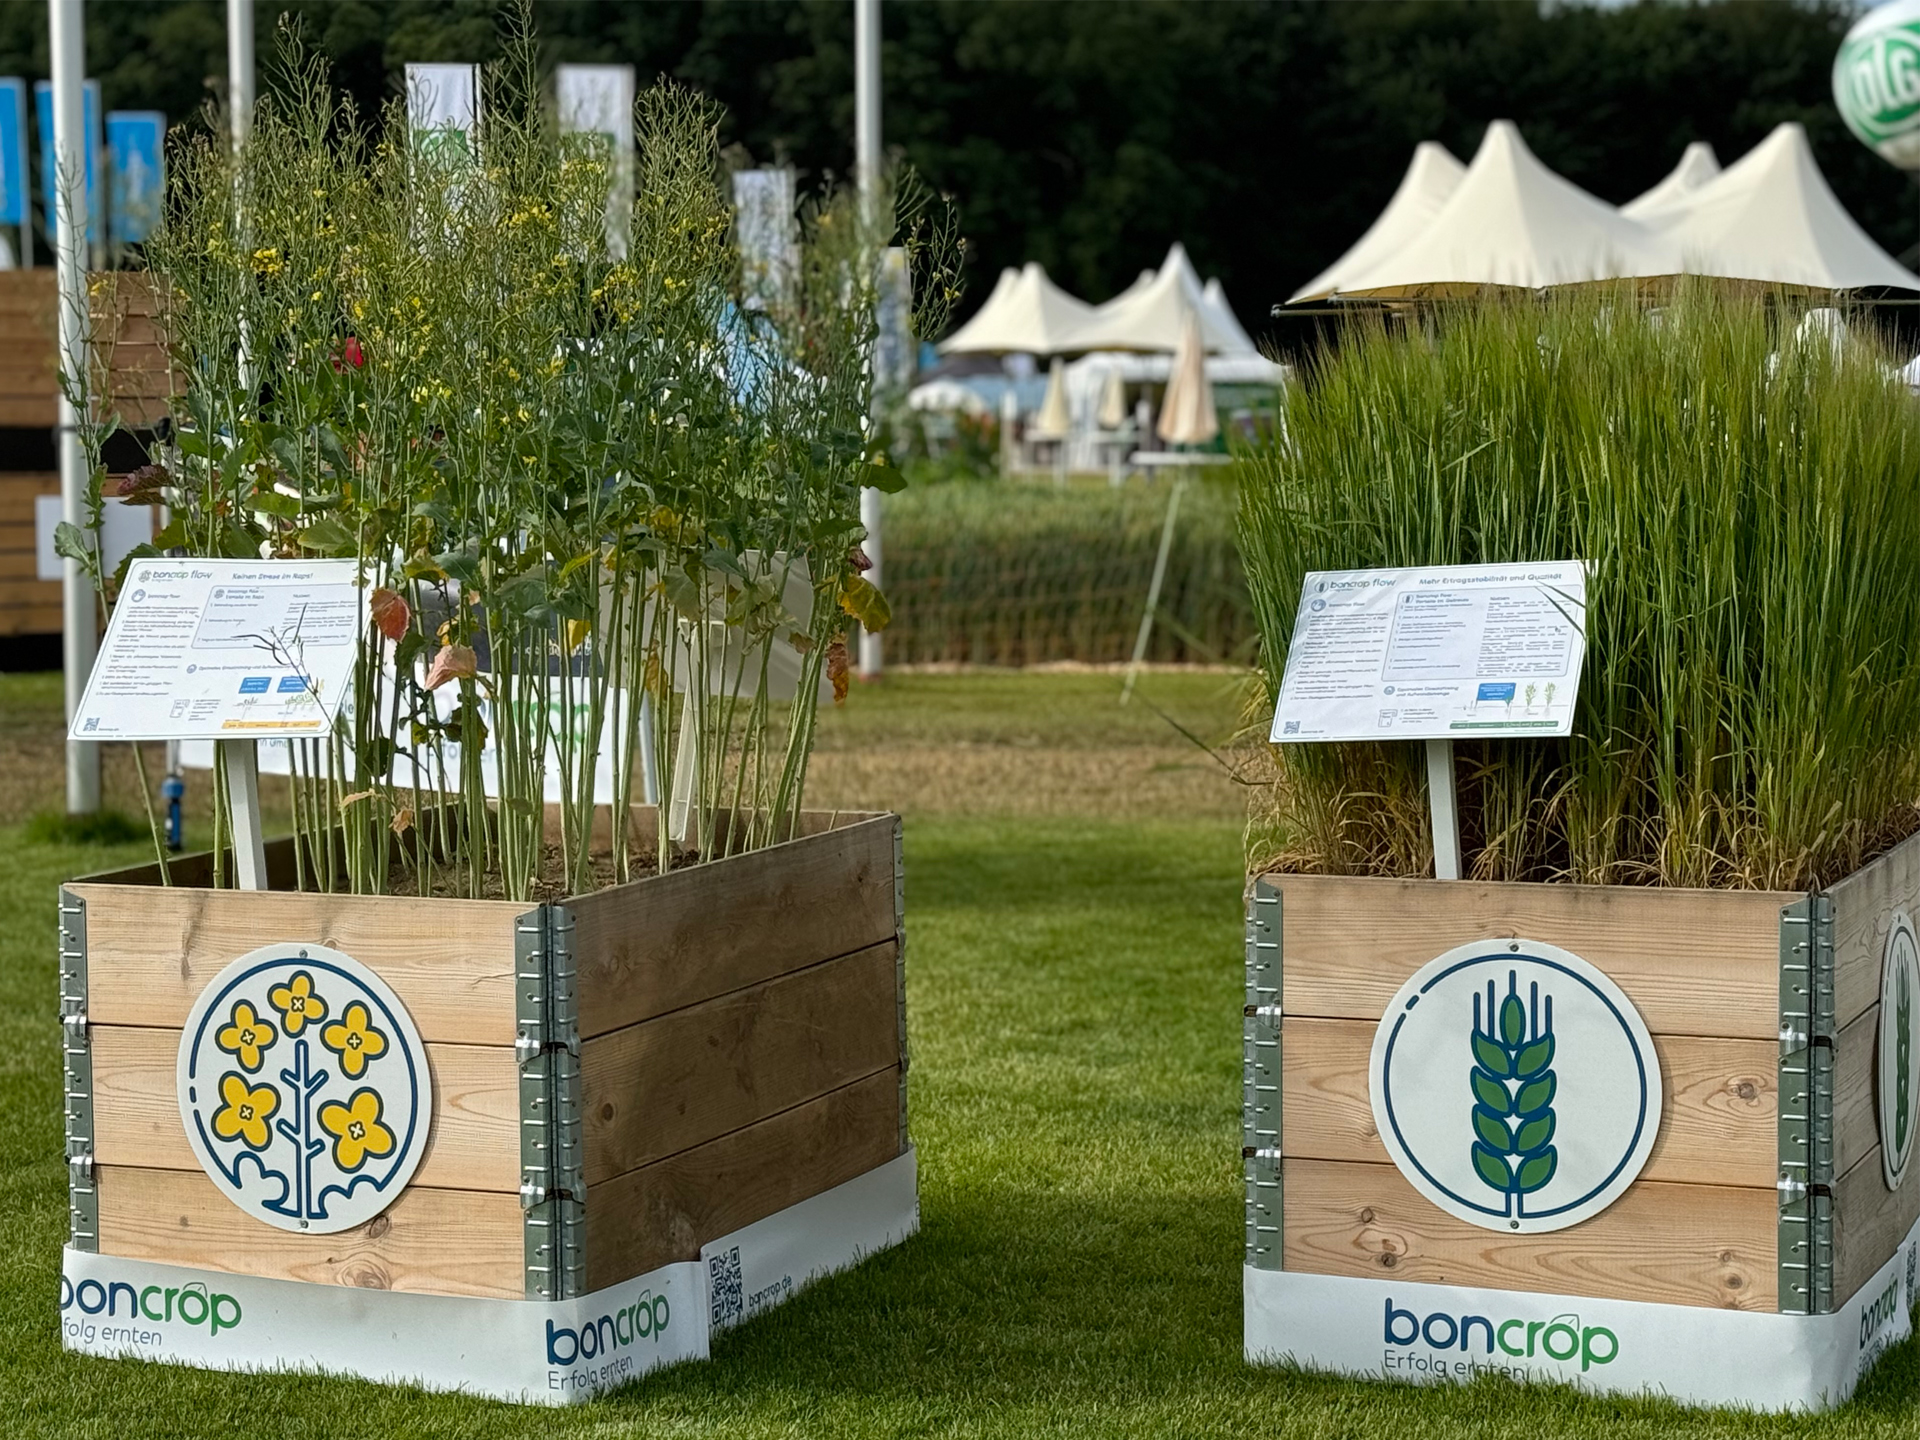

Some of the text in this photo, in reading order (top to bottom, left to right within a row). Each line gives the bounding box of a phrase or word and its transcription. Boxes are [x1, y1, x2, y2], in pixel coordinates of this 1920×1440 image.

[191, 570, 213, 579] flow
[1330, 578, 1397, 589] boncrop flow
[748, 1273, 792, 1307] boncrop.de
[1859, 1277, 1898, 1350] boncrop
[63, 1317, 162, 1346] folg ernten
[546, 1293, 670, 1366] boncrop
[1384, 1297, 1619, 1373] boncrop
[600, 1355, 634, 1381] ernten
[1384, 1349, 1447, 1379] Erfolg
